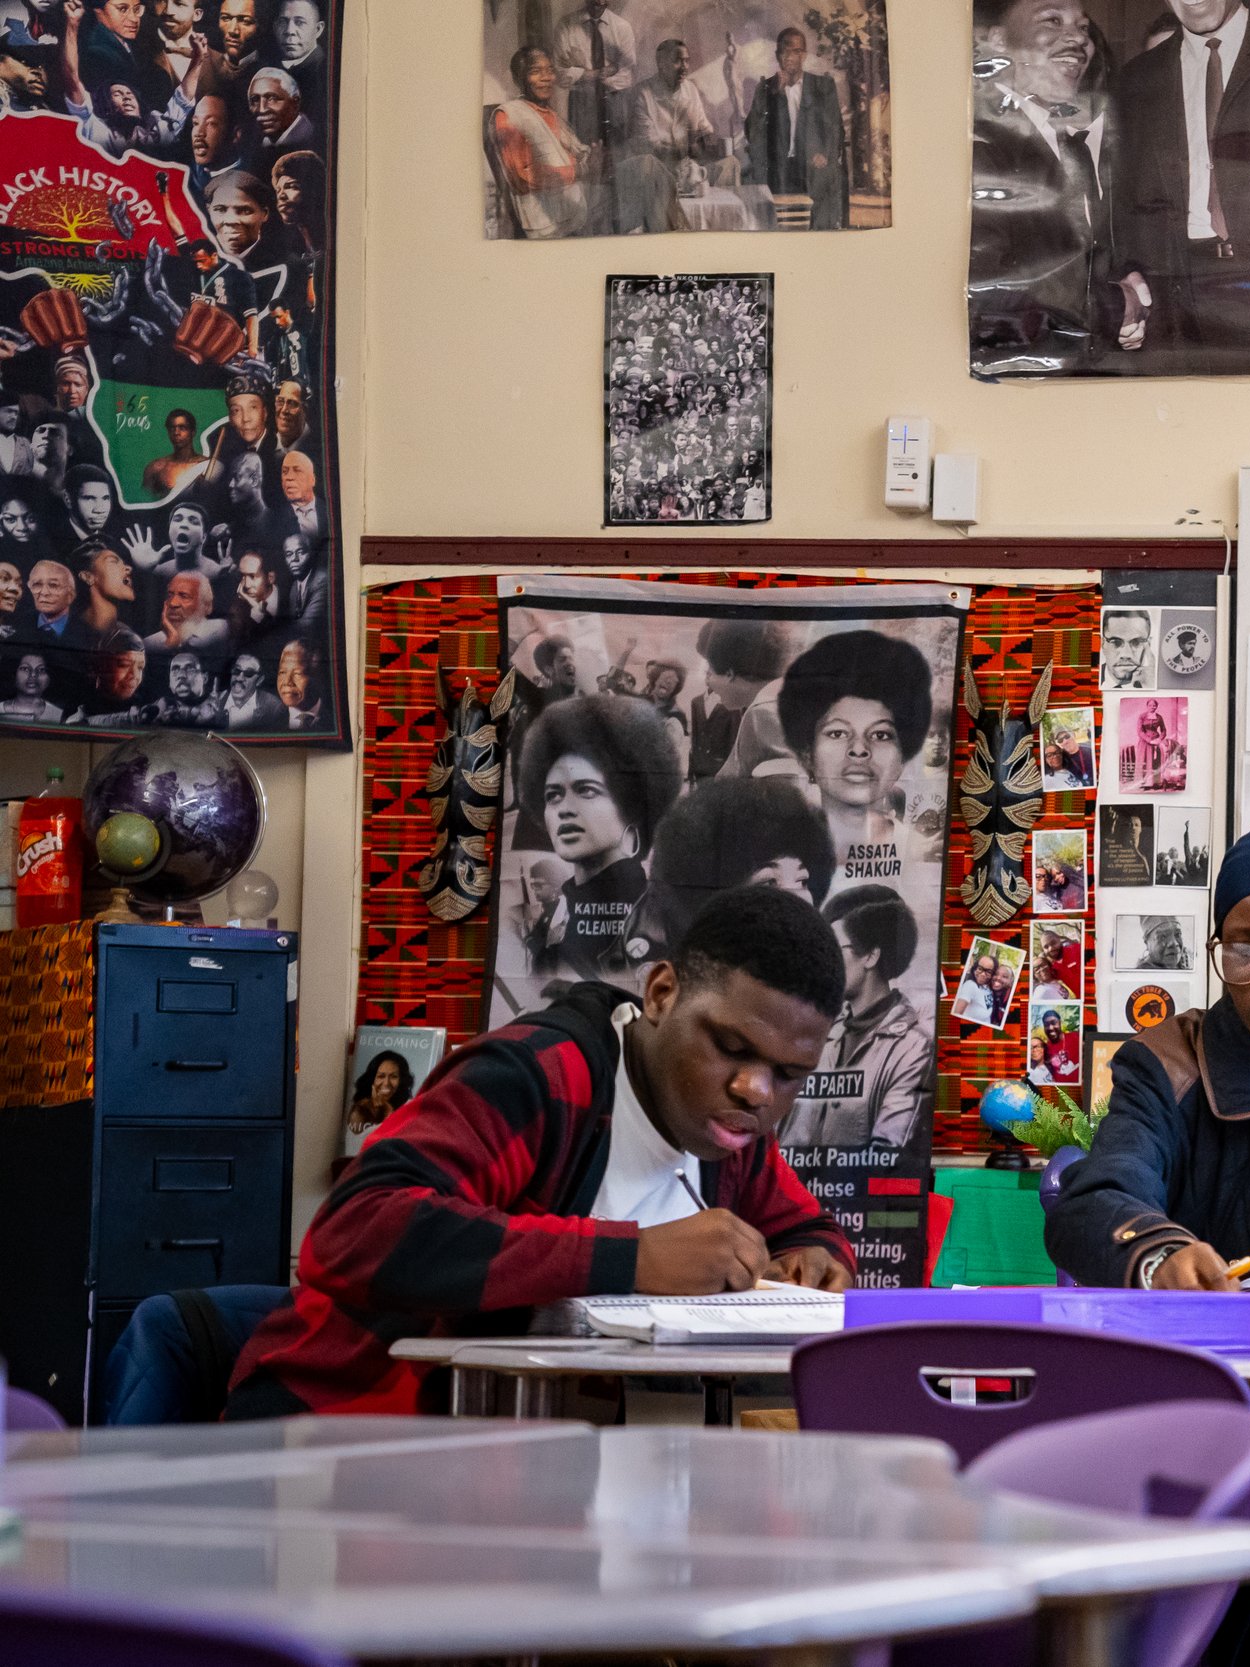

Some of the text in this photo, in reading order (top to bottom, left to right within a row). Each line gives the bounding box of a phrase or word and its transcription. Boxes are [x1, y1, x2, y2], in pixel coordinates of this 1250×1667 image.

[59, 166, 163, 228] HISTORY
[1, 241, 80, 257] STRONG
[15, 255, 66, 271] Amazing
[115, 412, 151, 434] Days
[1165, 625, 1210, 644] ALL POWER TO
[1166, 658, 1206, 673] THE PEOPLE
[17, 831, 63, 877] Crush
[847, 843, 897, 860] ASSATA
[845, 860, 902, 878] SHAKUR
[574, 902, 633, 916] KATHLEEN
[576, 919, 626, 936] CLEAVER
[359, 1035, 431, 1050] BECOMING
[818, 1074, 863, 1096] PARTY
[826, 1146, 900, 1168] Panther
[806, 1177, 856, 1198] these
